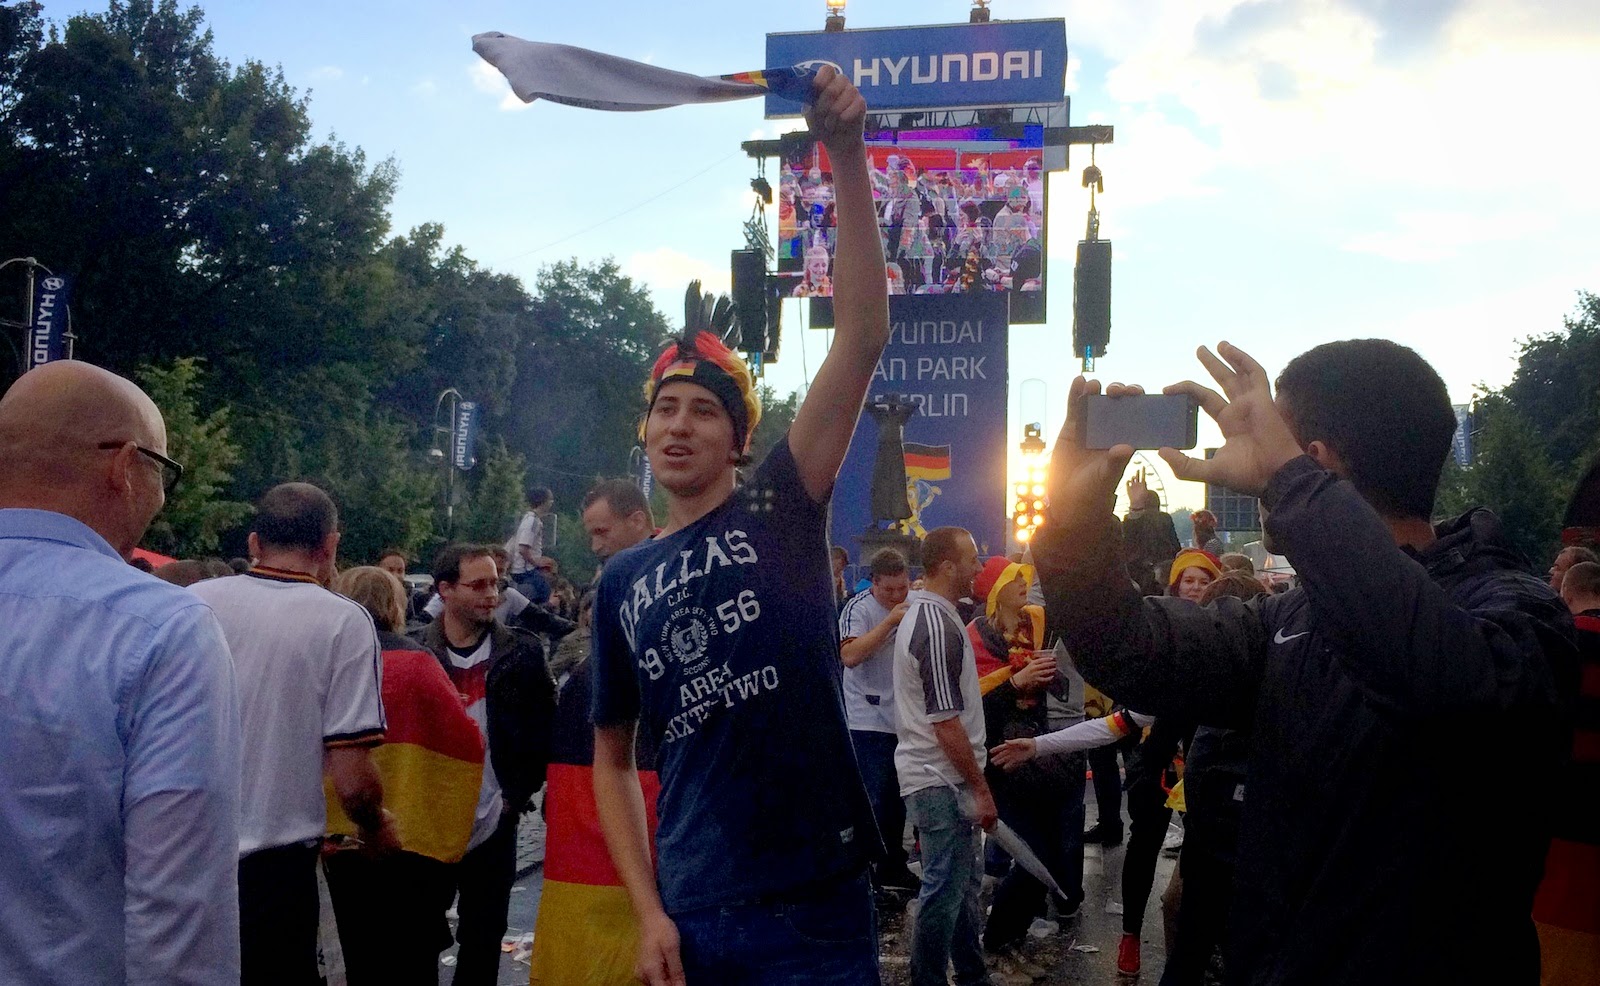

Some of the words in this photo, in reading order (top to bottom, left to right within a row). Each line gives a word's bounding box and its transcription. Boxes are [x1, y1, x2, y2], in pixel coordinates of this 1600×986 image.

[854, 50, 1043, 87] HYUNDAI
[889, 319, 983, 344] YUNDAI
[874, 357, 907, 381] AN
[917, 356, 987, 380] PARK
[619, 529, 759, 652] DALLAS
[716, 589, 761, 634] 56
[680, 660, 734, 708] AREA
